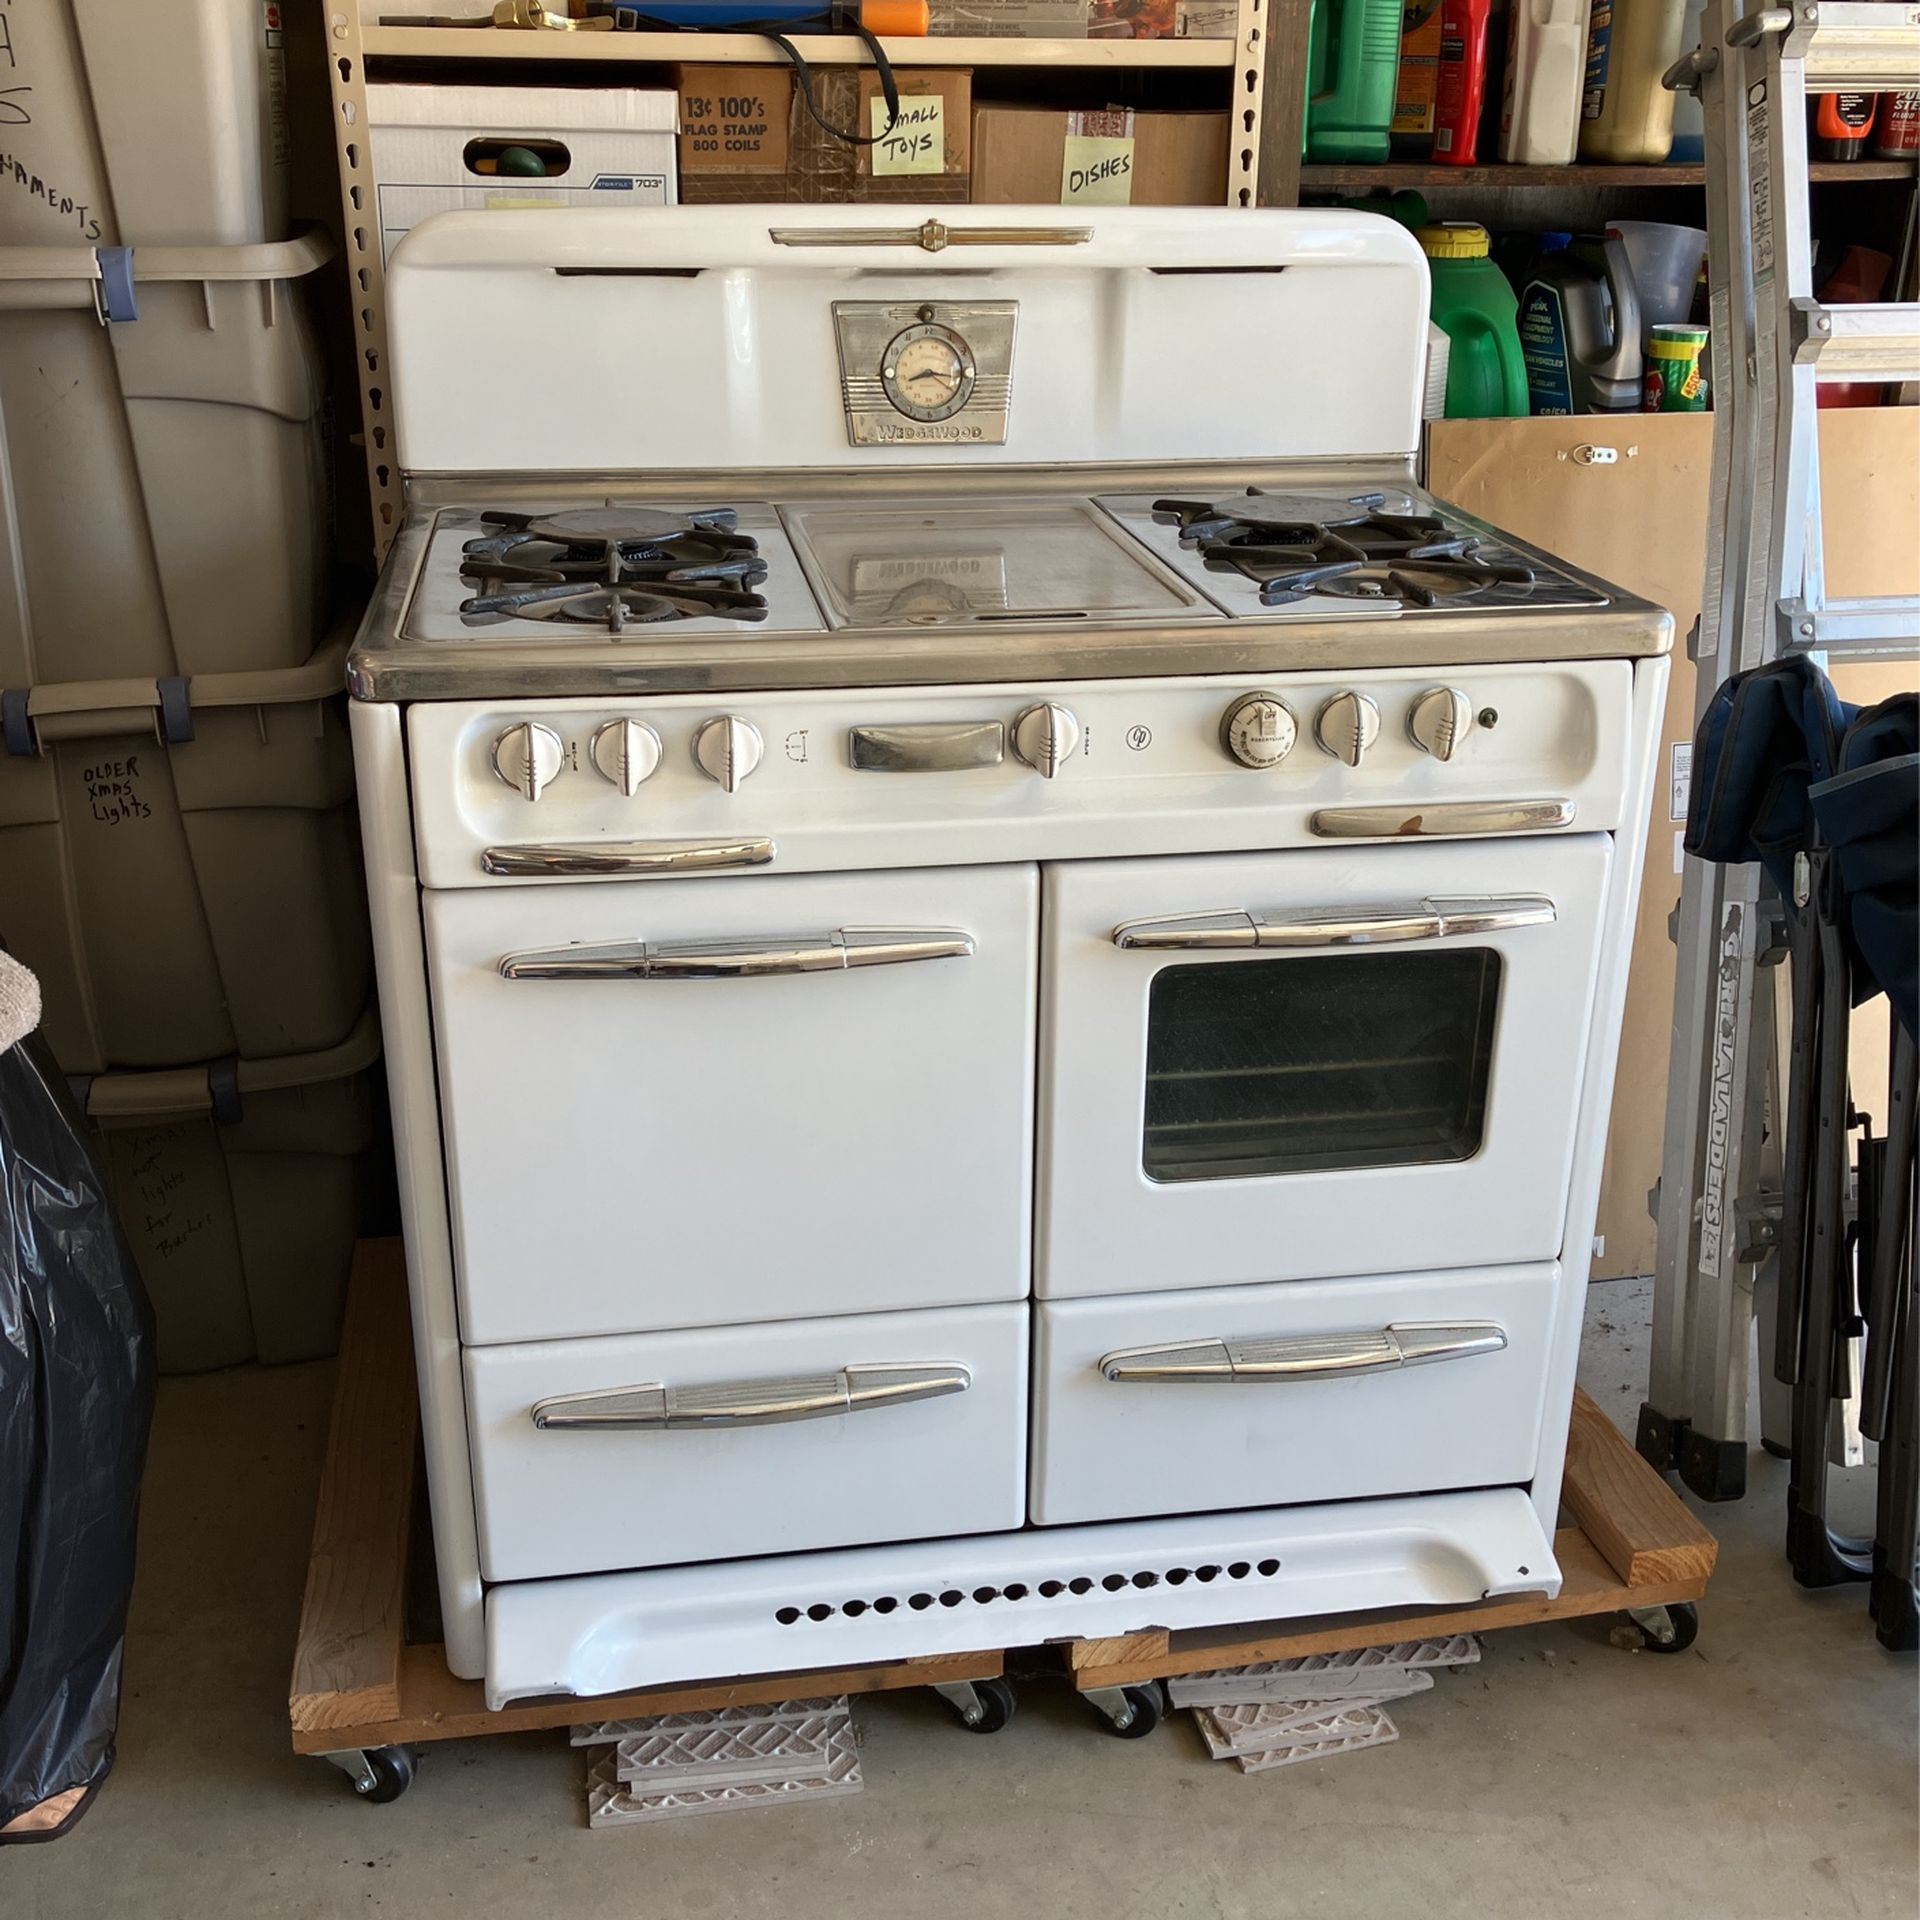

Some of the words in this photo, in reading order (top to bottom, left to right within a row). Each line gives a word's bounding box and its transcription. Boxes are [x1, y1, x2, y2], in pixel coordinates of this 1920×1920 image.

[685, 97, 712, 118] 13¢
[883, 105, 938, 131] SMALL
[685, 124, 717, 136] FLAG
[723, 124, 767, 136] STAMP
[693, 140, 718, 151] 800
[725, 140, 760, 151] COILS
[882, 133, 933, 161] TOYS
[1069, 153, 1131, 193] DISHES
[877, 424, 982, 440] WEDGEWOOD
[84, 756, 139, 782] OLDER
